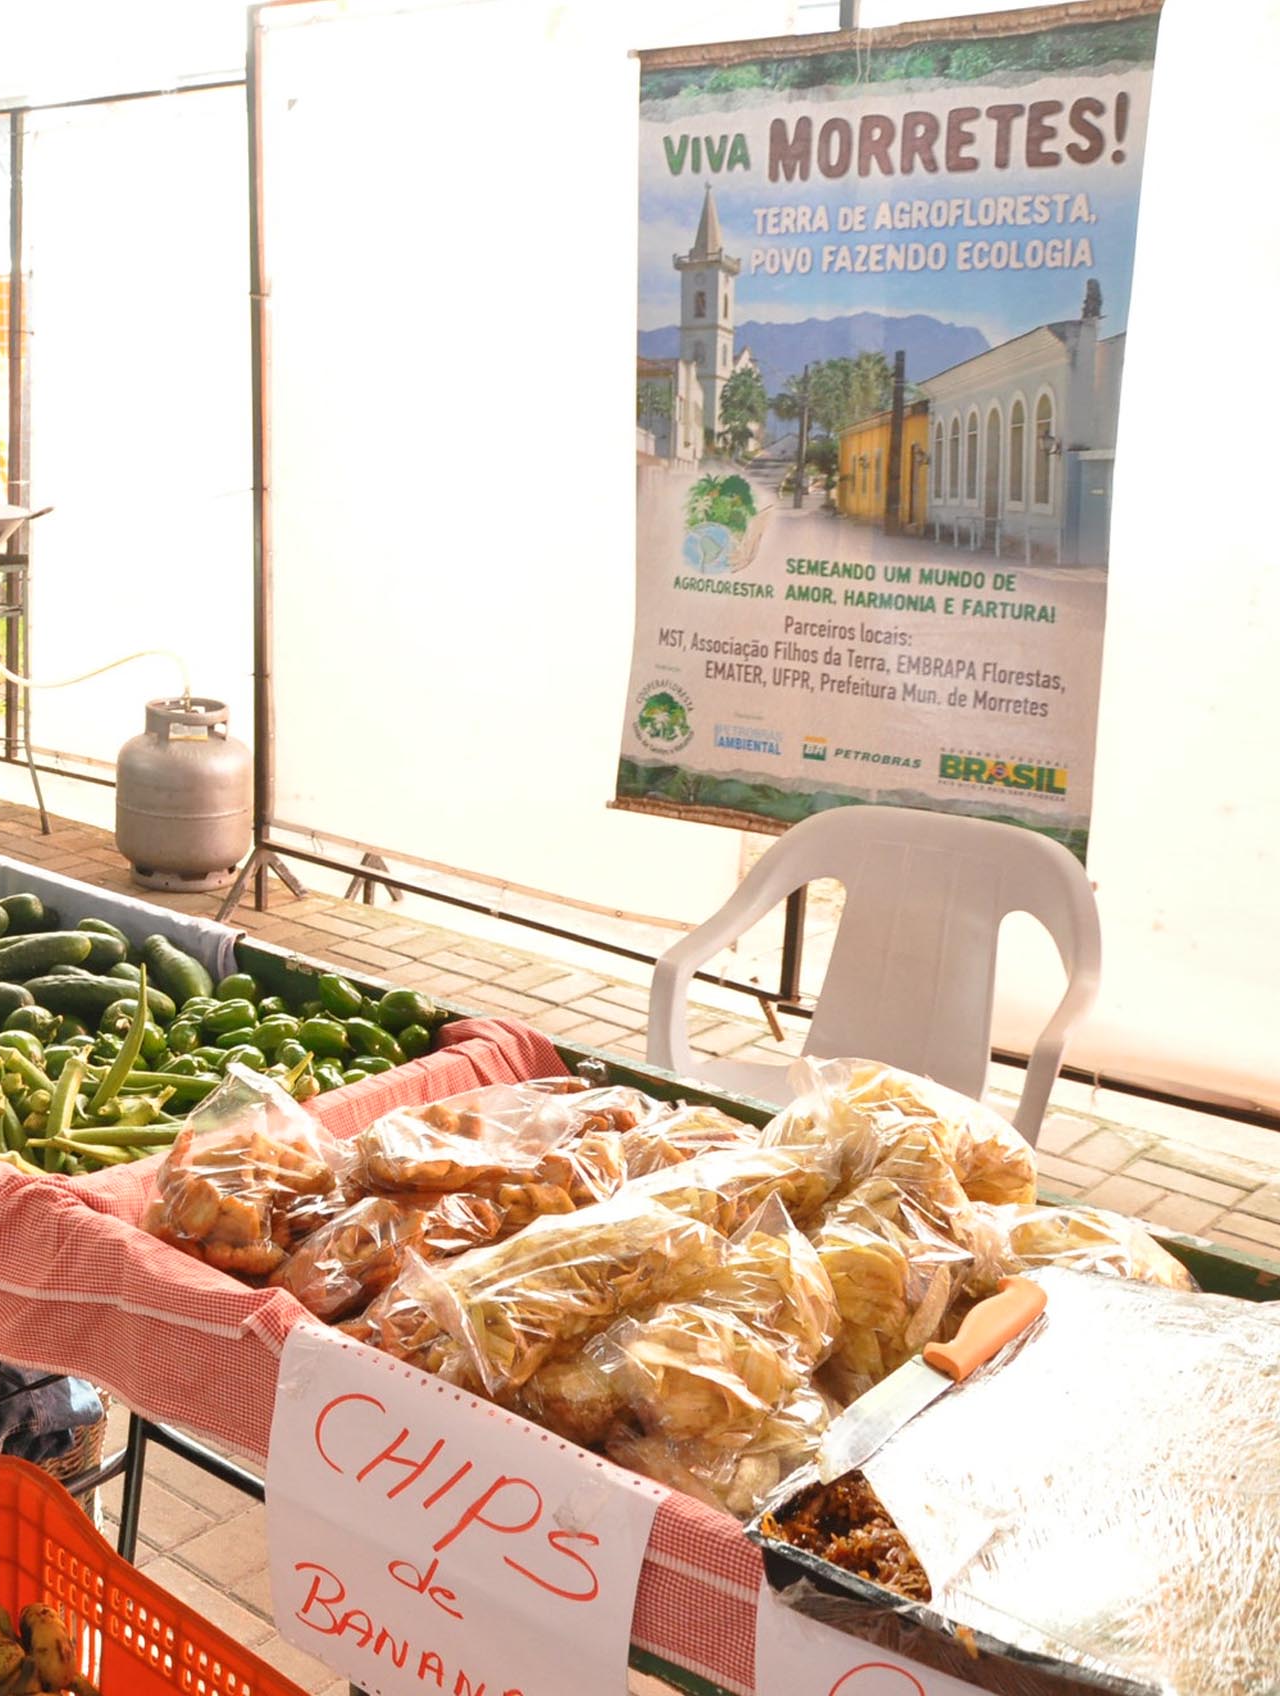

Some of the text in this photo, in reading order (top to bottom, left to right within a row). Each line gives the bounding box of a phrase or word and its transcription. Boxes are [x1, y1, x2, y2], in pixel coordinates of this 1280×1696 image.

[663, 91, 1130, 183] VIVA MORRETES!
[753, 193, 1097, 235] TERRA DE AGROFLORESTA,
[750, 238, 1093, 275] POVO FAZENDO ECOLOGIA
[673, 575, 774, 599] AGROFLORESTAR
[786, 558, 1017, 592] SEMEANDO UM MUNDO DE
[843, 590, 937, 614] HARMONIA
[944, 597, 954, 615] E
[961, 599, 1057, 624] FARTURA!
[784, 615, 913, 647] Parceiros locais:
[658, 627, 1066, 694] MST, Associação Filhos da Terra, EMBRAPA Florestas,
[705, 660, 1049, 718] EMATER, UFPR, Prefeitura Mun. de Morretes
[718, 736, 781, 755] AMBIENTAL
[834, 747, 922, 769] PETROBRAS
[939, 754, 1067, 795] BRASIL
[315, 1393, 600, 1602] CHIPS
[387, 1558, 464, 1620] de
[294, 1562, 525, 1696] BANAN
